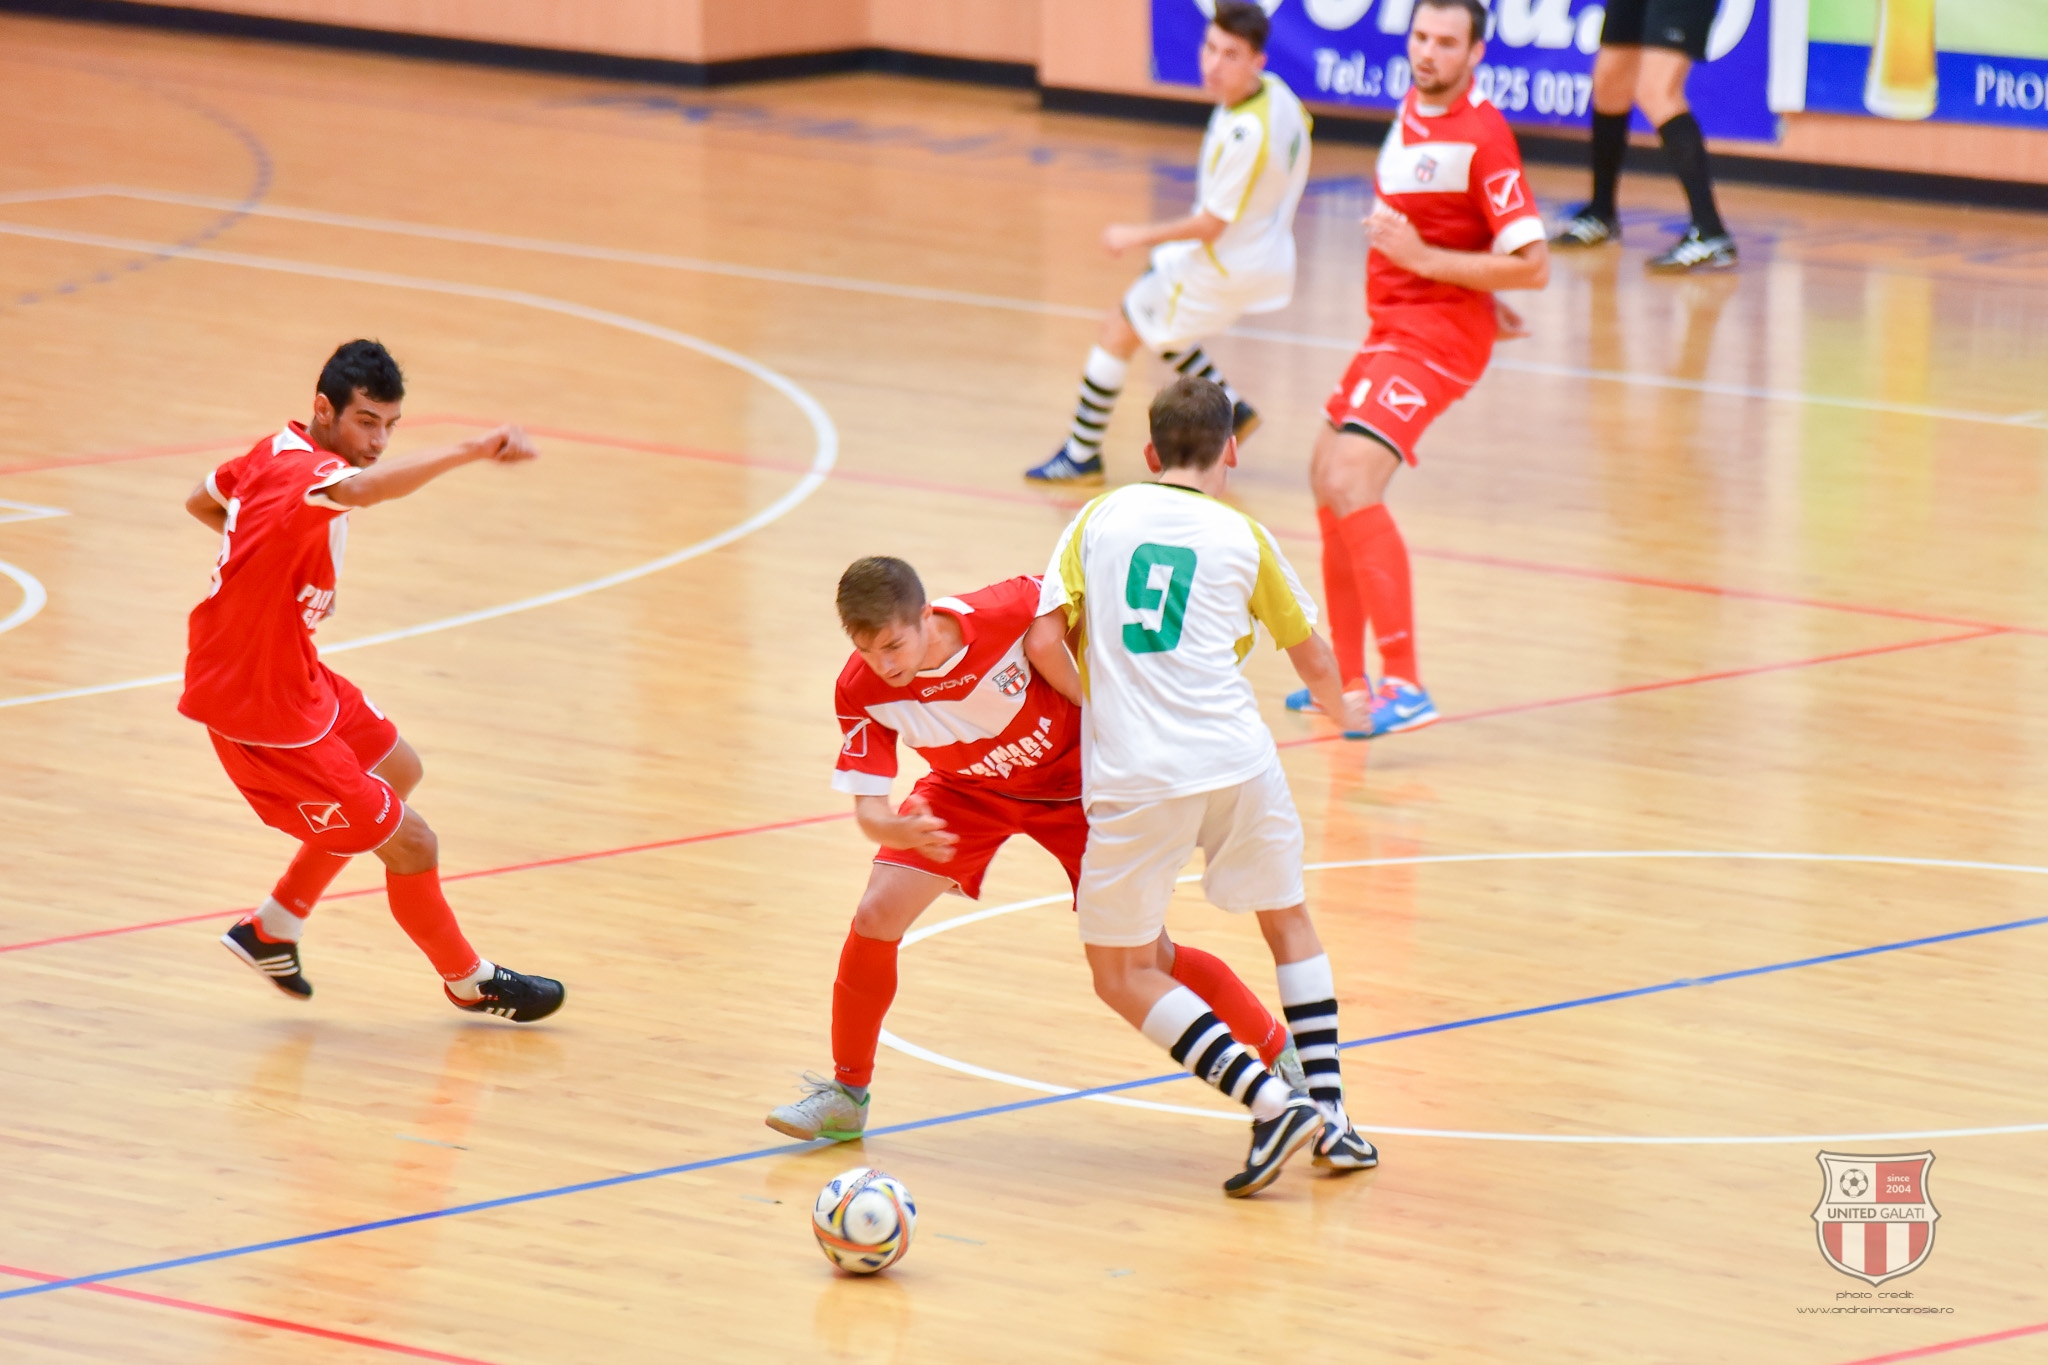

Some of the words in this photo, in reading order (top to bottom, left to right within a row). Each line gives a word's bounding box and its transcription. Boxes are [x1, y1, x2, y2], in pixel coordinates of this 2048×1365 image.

[1532, 70, 1594, 117] 007
[1975, 64, 2048, 111] PRO
[1122, 542, 1197, 654] 9
